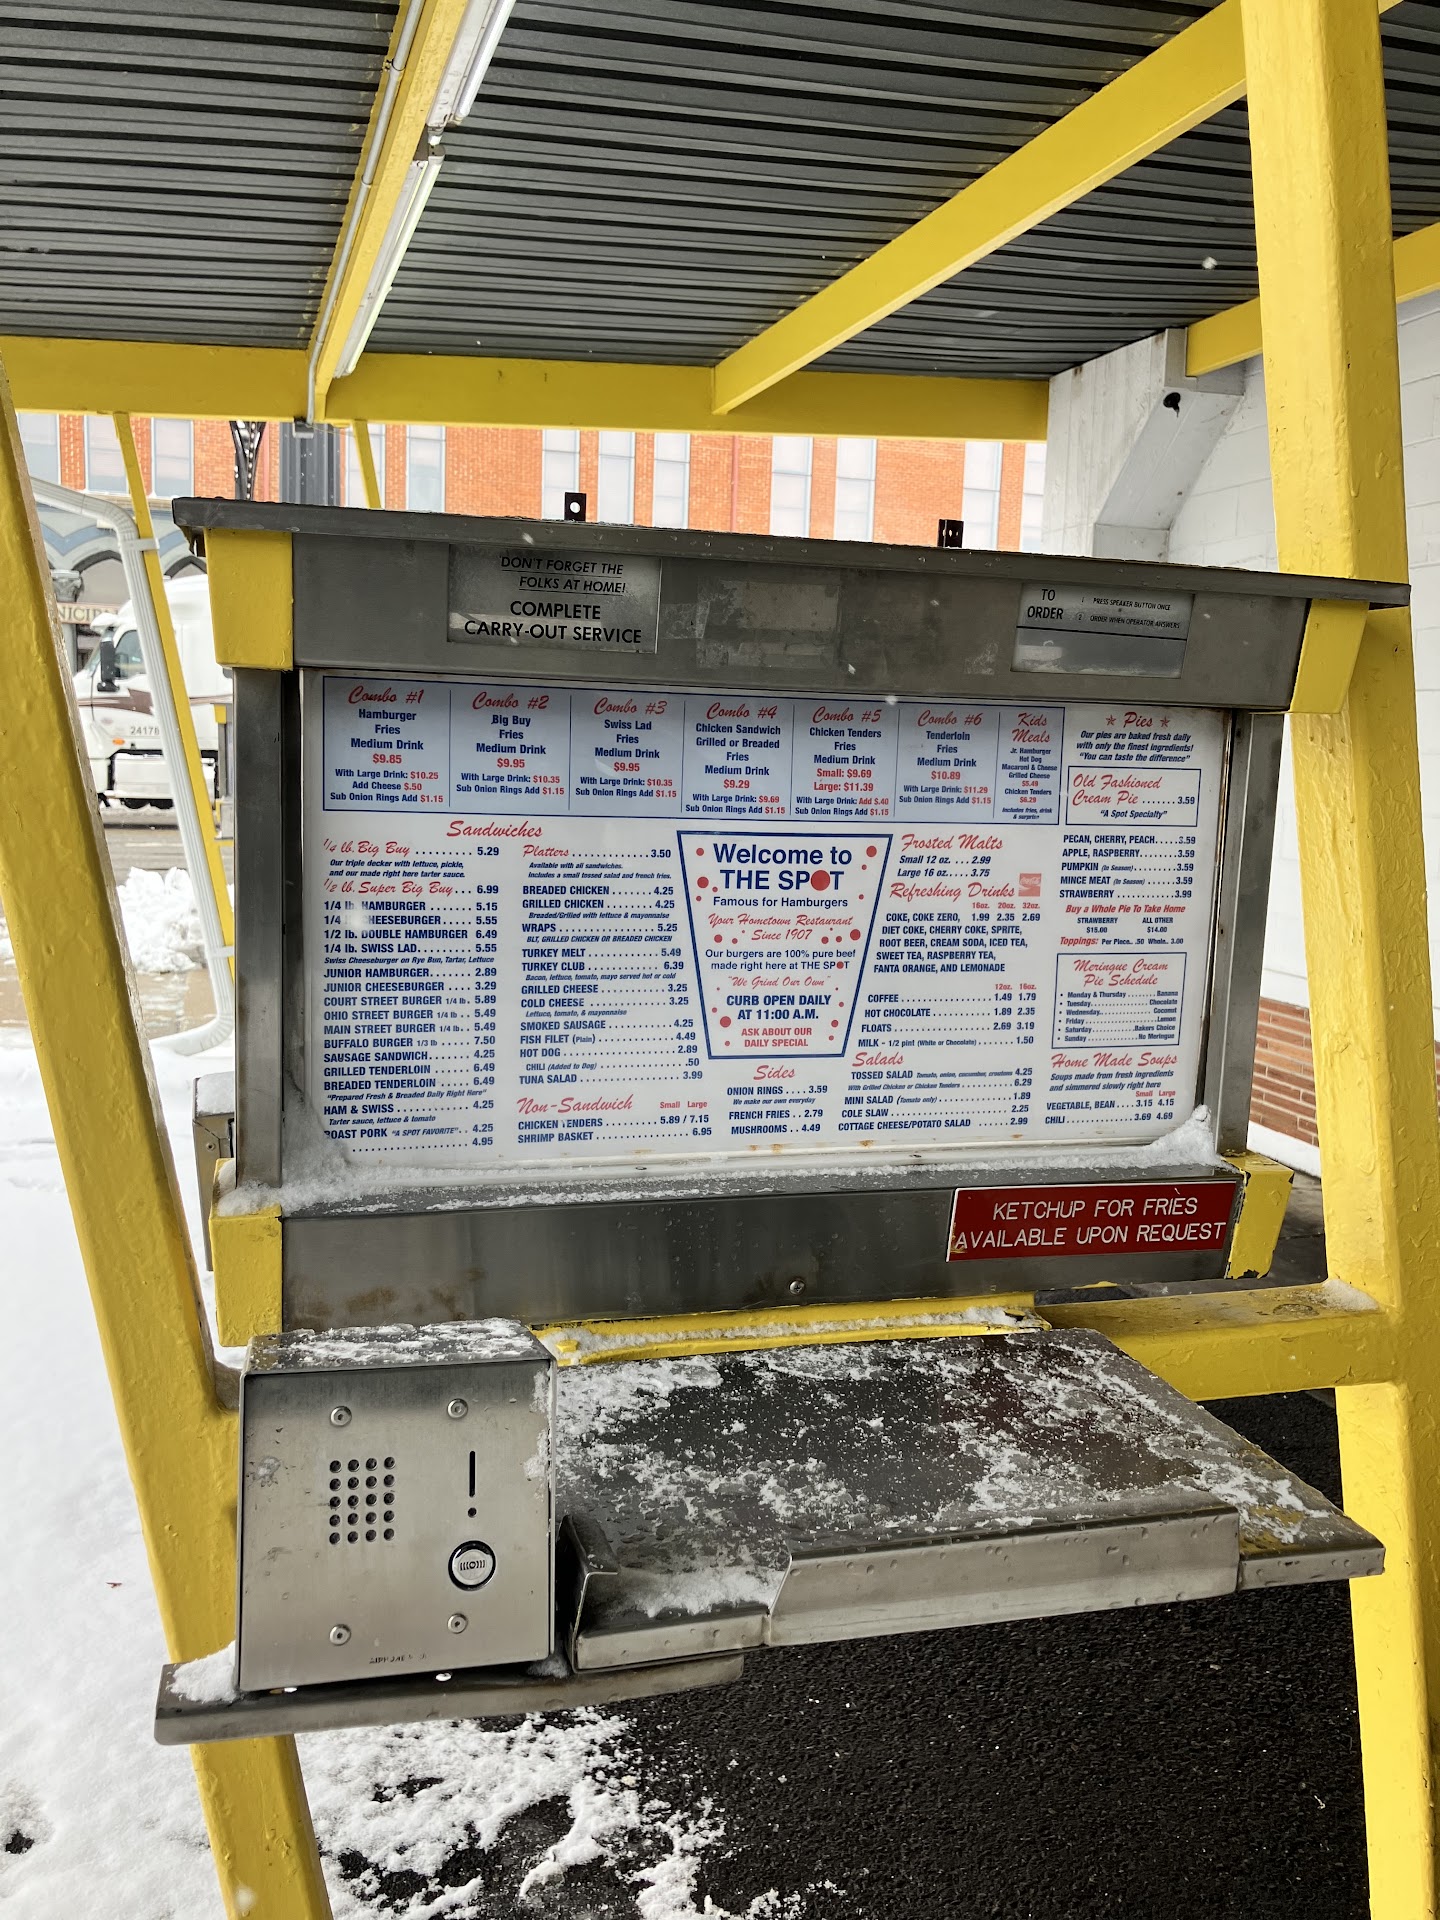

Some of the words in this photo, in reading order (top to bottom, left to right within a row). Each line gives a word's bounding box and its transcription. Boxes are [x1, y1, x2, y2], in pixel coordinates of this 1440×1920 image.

[501, 557, 542, 569] DON'T
[546, 560, 597, 573] FORGET
[601, 564, 623, 574] THE
[520, 577, 559, 588] FOLKS
[563, 579, 580, 589] AT
[584, 581, 626, 592] HOME!
[1042, 589, 1055, 600] TO
[1110, 599, 1133, 607] SPEAKER
[510, 601, 600, 619] COMPLETE
[1027, 606, 1063, 619] ORDER
[464, 621, 567, 639] CARRY-OUT
[573, 627, 641, 643] SERVICE
[348, 686, 397, 704] Combo
[406, 690, 424, 703] #1
[472, 692, 519, 709] Combo
[528, 695, 549, 709] #2
[594, 697, 637, 715] Combo
[646, 701, 667, 715] #3
[706, 703, 750, 719] Combo
[758, 705, 778, 719] #4
[359, 709, 416, 721] Hamburger
[491, 715, 509, 726] Big
[513, 716, 531, 726] Buy
[813, 706, 854, 723] Combo
[861, 709, 881, 722] #5
[917, 710, 957, 726] Combo
[964, 713, 982, 725] #6
[1018, 713, 1048, 726] Kids
[1124, 712, 1153, 728] Pies
[1012, 729, 1050, 743] Meals
[1096, 732, 1111, 740] pies
[1173, 734, 1191, 742] daily
[351, 738, 393, 749] Medium
[397, 740, 424, 750] Drink
[373, 754, 402, 764] $9.85
[497, 758, 525, 768] $9.95
[817, 768, 844, 777] Small:
[847, 769, 872, 778] $9.69
[931, 771, 960, 780] $10.89
[724, 779, 750, 788] $9.29
[1073, 774, 1097, 787] Old
[1101, 775, 1162, 790] Fashioned
[1072, 790, 1111, 806] Cream
[1117, 790, 1138, 804] Pie
[447, 820, 542, 837] Sandwiches
[901, 834, 954, 851] Frosted
[958, 834, 1003, 849] Malts
[523, 844, 569, 858] Platters
[651, 850, 671, 858] 3.50
[713, 843, 823, 864] Welcome
[830, 846, 852, 864] to
[1063, 849, 1090, 858] APPLE,
[1093, 849, 1140, 857] RASPBERRY
[720, 870, 769, 889] THE
[898, 869, 921, 878] Large
[890, 882, 962, 902] Refreshing
[968, 882, 1015, 897] Drinks
[1059, 890, 1114, 898] STRAWBERRY
[714, 897, 758, 906] Famous
[762, 897, 778, 906] for
[782, 898, 848, 909] Hamburgers
[708, 914, 734, 928] Your
[737, 914, 791, 925] Hometown
[796, 915, 853, 925] Restaurant
[886, 913, 910, 923] COKE,
[913, 913, 934, 921] COKE
[937, 913, 960, 922] ZERO,
[972, 913, 990, 921] 1.99
[997, 913, 1014, 921] 2.35
[1022, 913, 1040, 921] 2.69
[522, 924, 556, 932] WRAPS
[658, 923, 677, 932] 5.25
[752, 929, 781, 940] Since
[786, 929, 813, 940] 1907
[324, 944, 341, 953] 1/4
[345, 944, 357, 952] lb.
[362, 944, 394, 952] SWISS
[398, 944, 417, 952] LAD
[475, 944, 497, 952] 5.55
[726, 950, 763, 960] burgers
[813, 952, 833, 960] pure
[837, 950, 856, 958] beef
[711, 962, 737, 970] made
[741, 962, 762, 971] right
[1073, 960, 1128, 975] Meringue
[1133, 959, 1168, 973] Cream
[752, 976, 779, 989] Grind
[783, 976, 800, 987] Our
[1084, 974, 1104, 987] Pie
[1108, 974, 1158, 986] Schedule
[727, 996, 759, 1006] CURB
[764, 995, 796, 1005] OPEN
[800, 995, 831, 1005] DAILY
[738, 1010, 753, 1020] AT
[757, 1009, 789, 1019] 11:00
[793, 1009, 819, 1019] A.M.
[741, 1028, 759, 1036] ASK
[762, 1028, 791, 1036] ABOUT
[324, 1039, 369, 1049] BUFFALO
[373, 1038, 413, 1047] BURGER
[474, 1036, 495, 1044] 7.50
[744, 1039, 768, 1047] DAILY
[772, 1039, 808, 1047] SPECIAL
[324, 1053, 371, 1062] SAUSAGE
[374, 1051, 428, 1061] SANDWICH
[474, 1050, 495, 1058] 4.25
[852, 1052, 904, 1067] Salads
[1051, 1053, 1088, 1068] Home
[1093, 1053, 1132, 1066] Made
[1137, 1052, 1178, 1068] Soups
[519, 1075, 544, 1084] TUNA
[547, 1074, 577, 1083] SALAD
[683, 1071, 702, 1079] 3.99
[753, 1065, 795, 1080] Sides
[324, 1081, 371, 1090] BREADED
[375, 1079, 436, 1089] TENDERLOIN
[474, 1077, 495, 1085] 6.49
[727, 1087, 754, 1096] ONION
[757, 1086, 783, 1095] RINGS
[517, 1094, 634, 1115] Non-Sandwich
[361, 1128, 387, 1138] PORK
[473, 1124, 493, 1132] 4.25
[518, 1133, 554, 1143] SHRIMP
[558, 1132, 593, 1142] BASKET
[693, 1128, 712, 1136] 6.95
[993, 1200, 1086, 1221] KETCHUP
[1094, 1200, 1133, 1218] FOR
[1143, 1198, 1198, 1216] FRIES
[955, 1228, 1067, 1250] AVAILABLE
[1076, 1226, 1129, 1244] UPON
[1136, 1222, 1226, 1242] REQUEST
